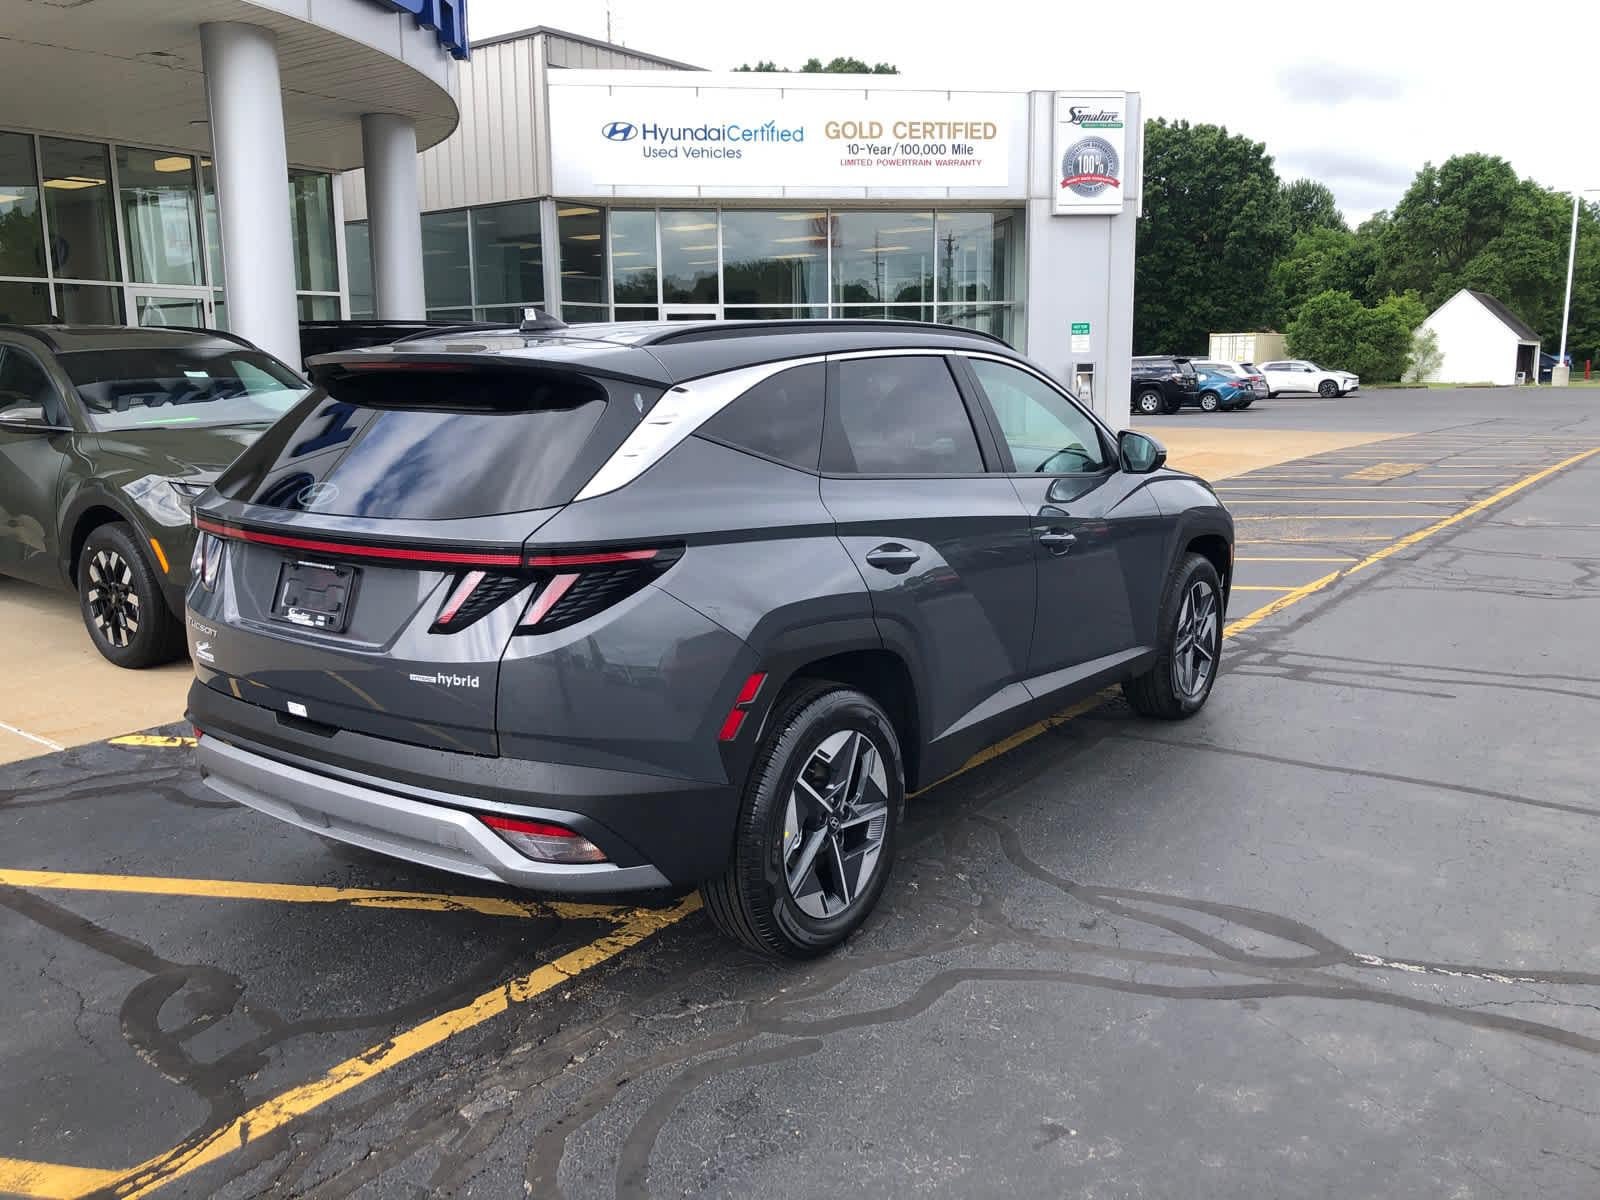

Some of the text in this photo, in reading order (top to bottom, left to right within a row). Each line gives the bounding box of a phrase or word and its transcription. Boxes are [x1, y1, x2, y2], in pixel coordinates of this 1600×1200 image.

[1060, 106, 1121, 125] Signature
[642, 122, 804, 144] HyundaiCertified
[825, 121, 997, 140] GOLD CERTIFIED
[643, 146, 742, 159] Used Vehicles
[847, 143, 974, 156] 10-Year/100,000 Mile
[840, 159, 982, 167] LIMITED POWERTRAIN WARRANTY
[1078, 154, 1104, 174] 100%
[437, 672, 480, 689] hybrid
